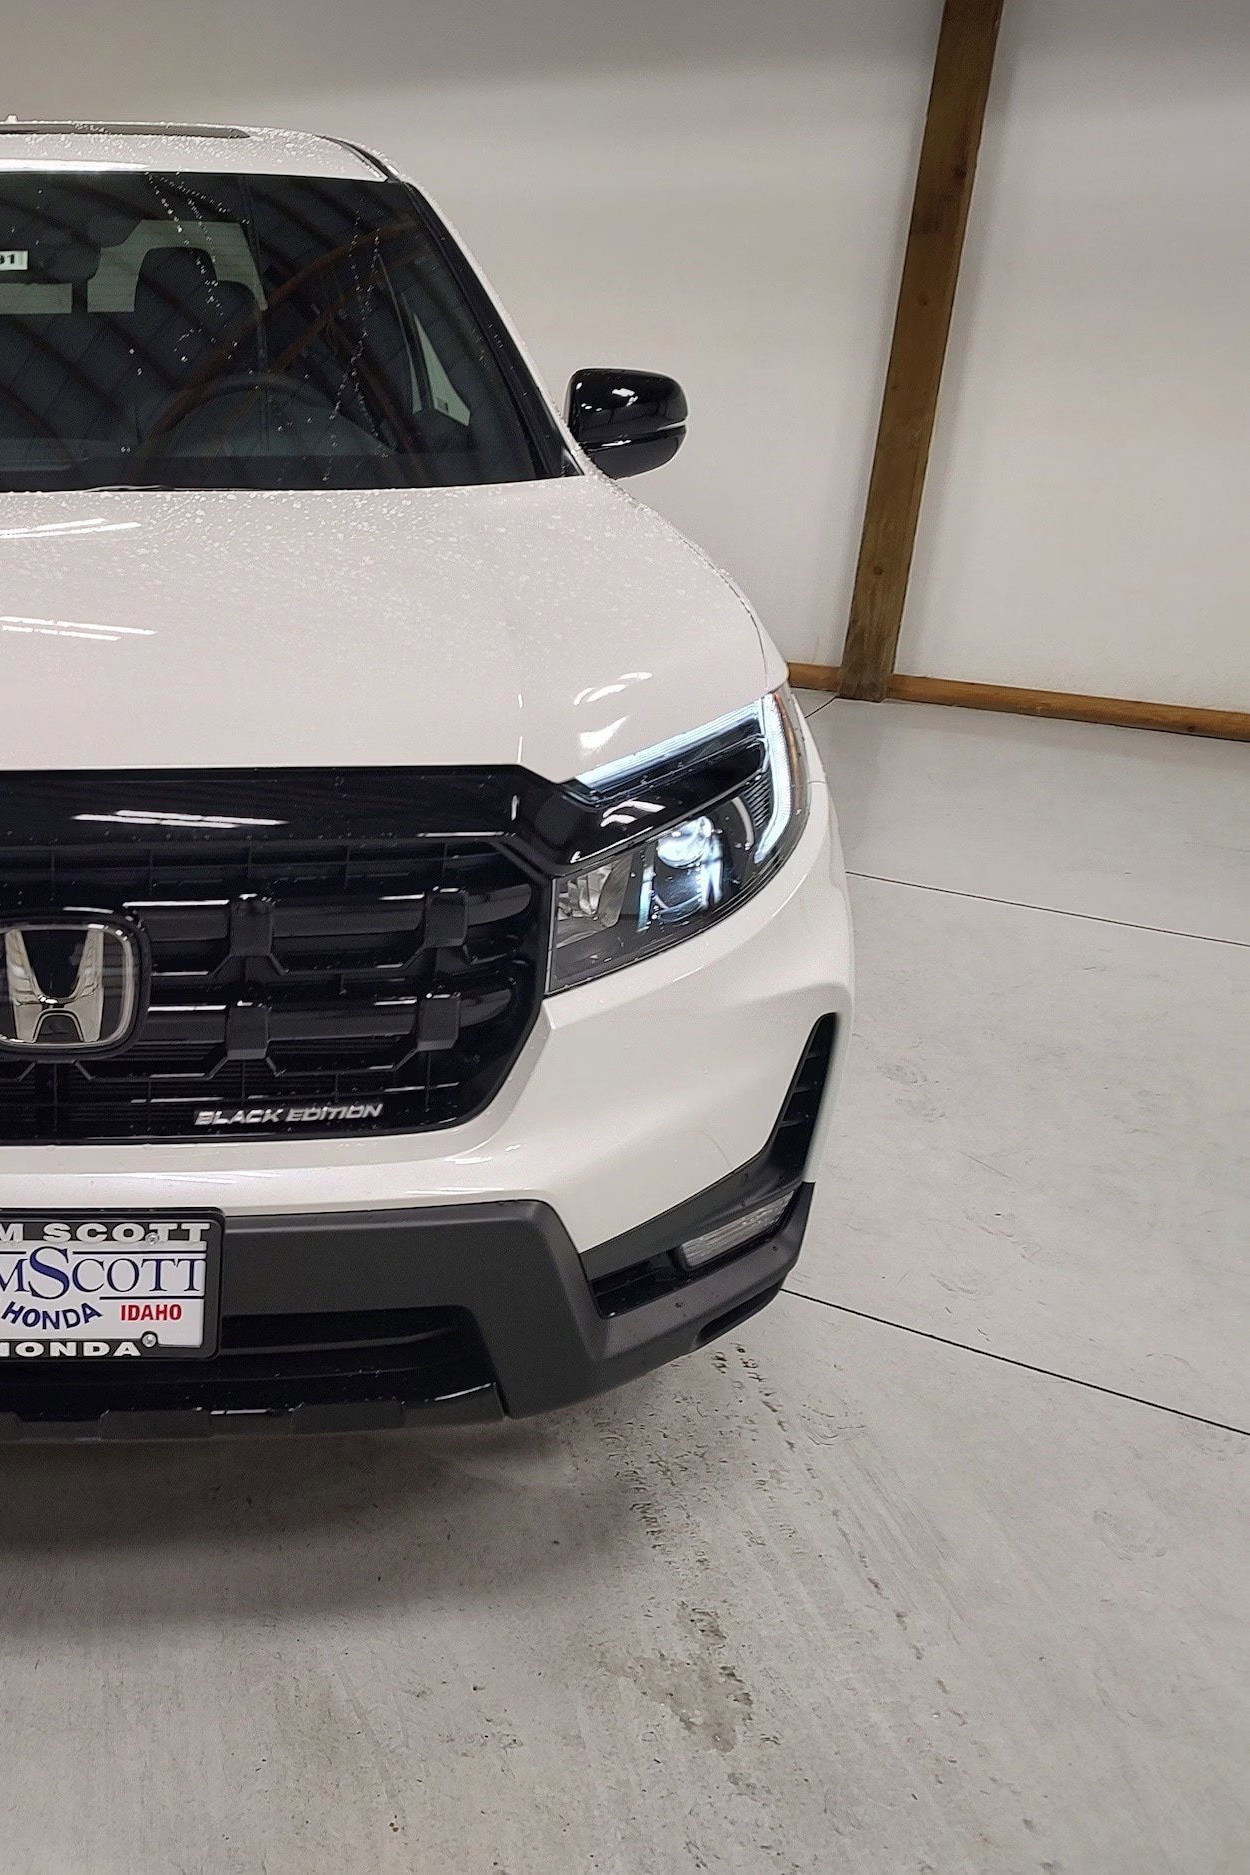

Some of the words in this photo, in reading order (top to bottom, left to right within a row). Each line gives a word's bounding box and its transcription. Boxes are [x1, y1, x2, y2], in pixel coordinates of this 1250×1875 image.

[194, 1108, 285, 1125] BLACK
[284, 1103, 384, 1122] EDITION
[42, 1223, 210, 1243] SCOTT
[1, 1301, 103, 1330] HONDA
[120, 1304, 182, 1321] IDAHO
